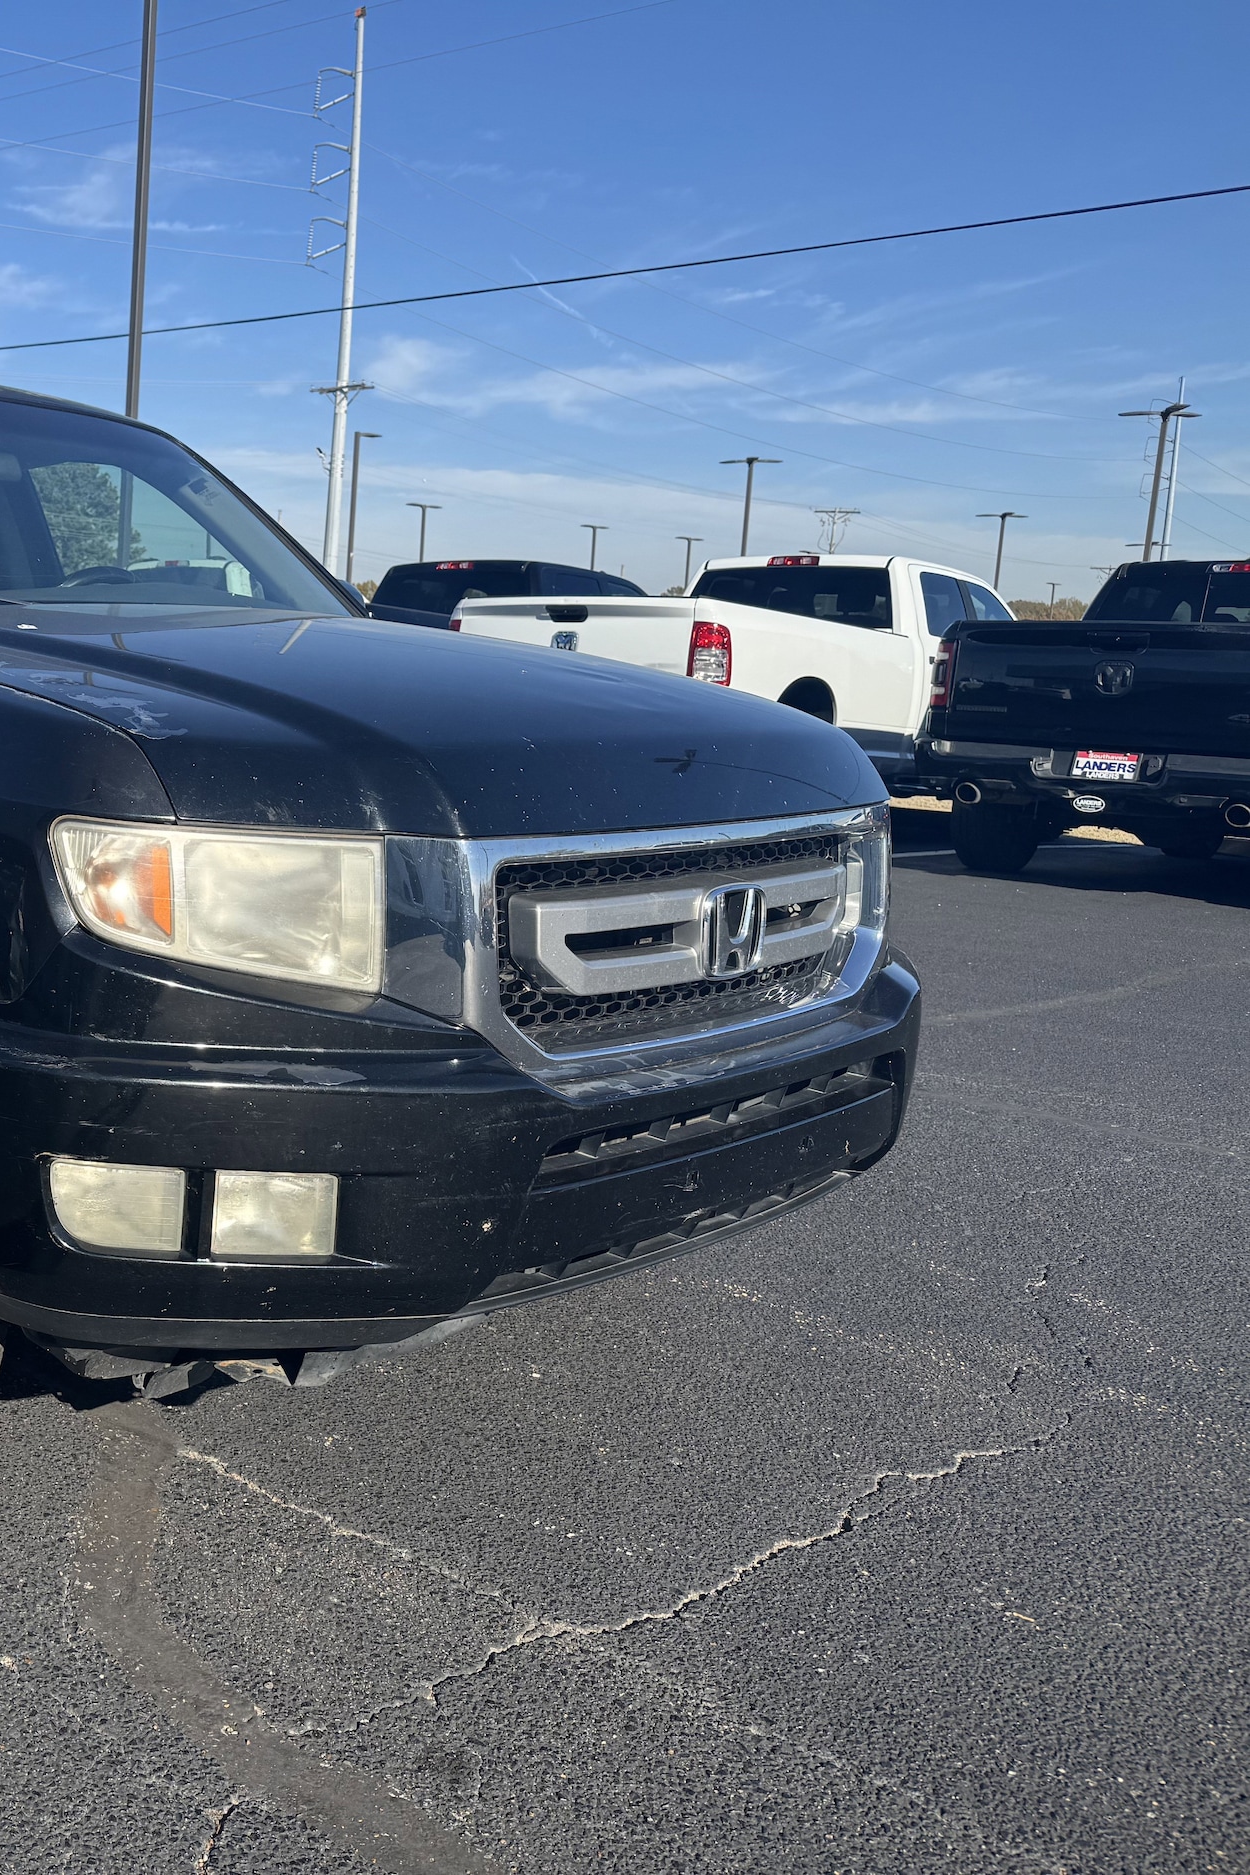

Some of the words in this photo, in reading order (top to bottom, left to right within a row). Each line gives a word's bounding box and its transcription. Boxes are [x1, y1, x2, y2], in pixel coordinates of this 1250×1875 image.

[1088, 752, 1127, 761] Southaven
[1075, 760, 1136, 773] LANDERS
[1085, 771, 1119, 780] LANDERS
